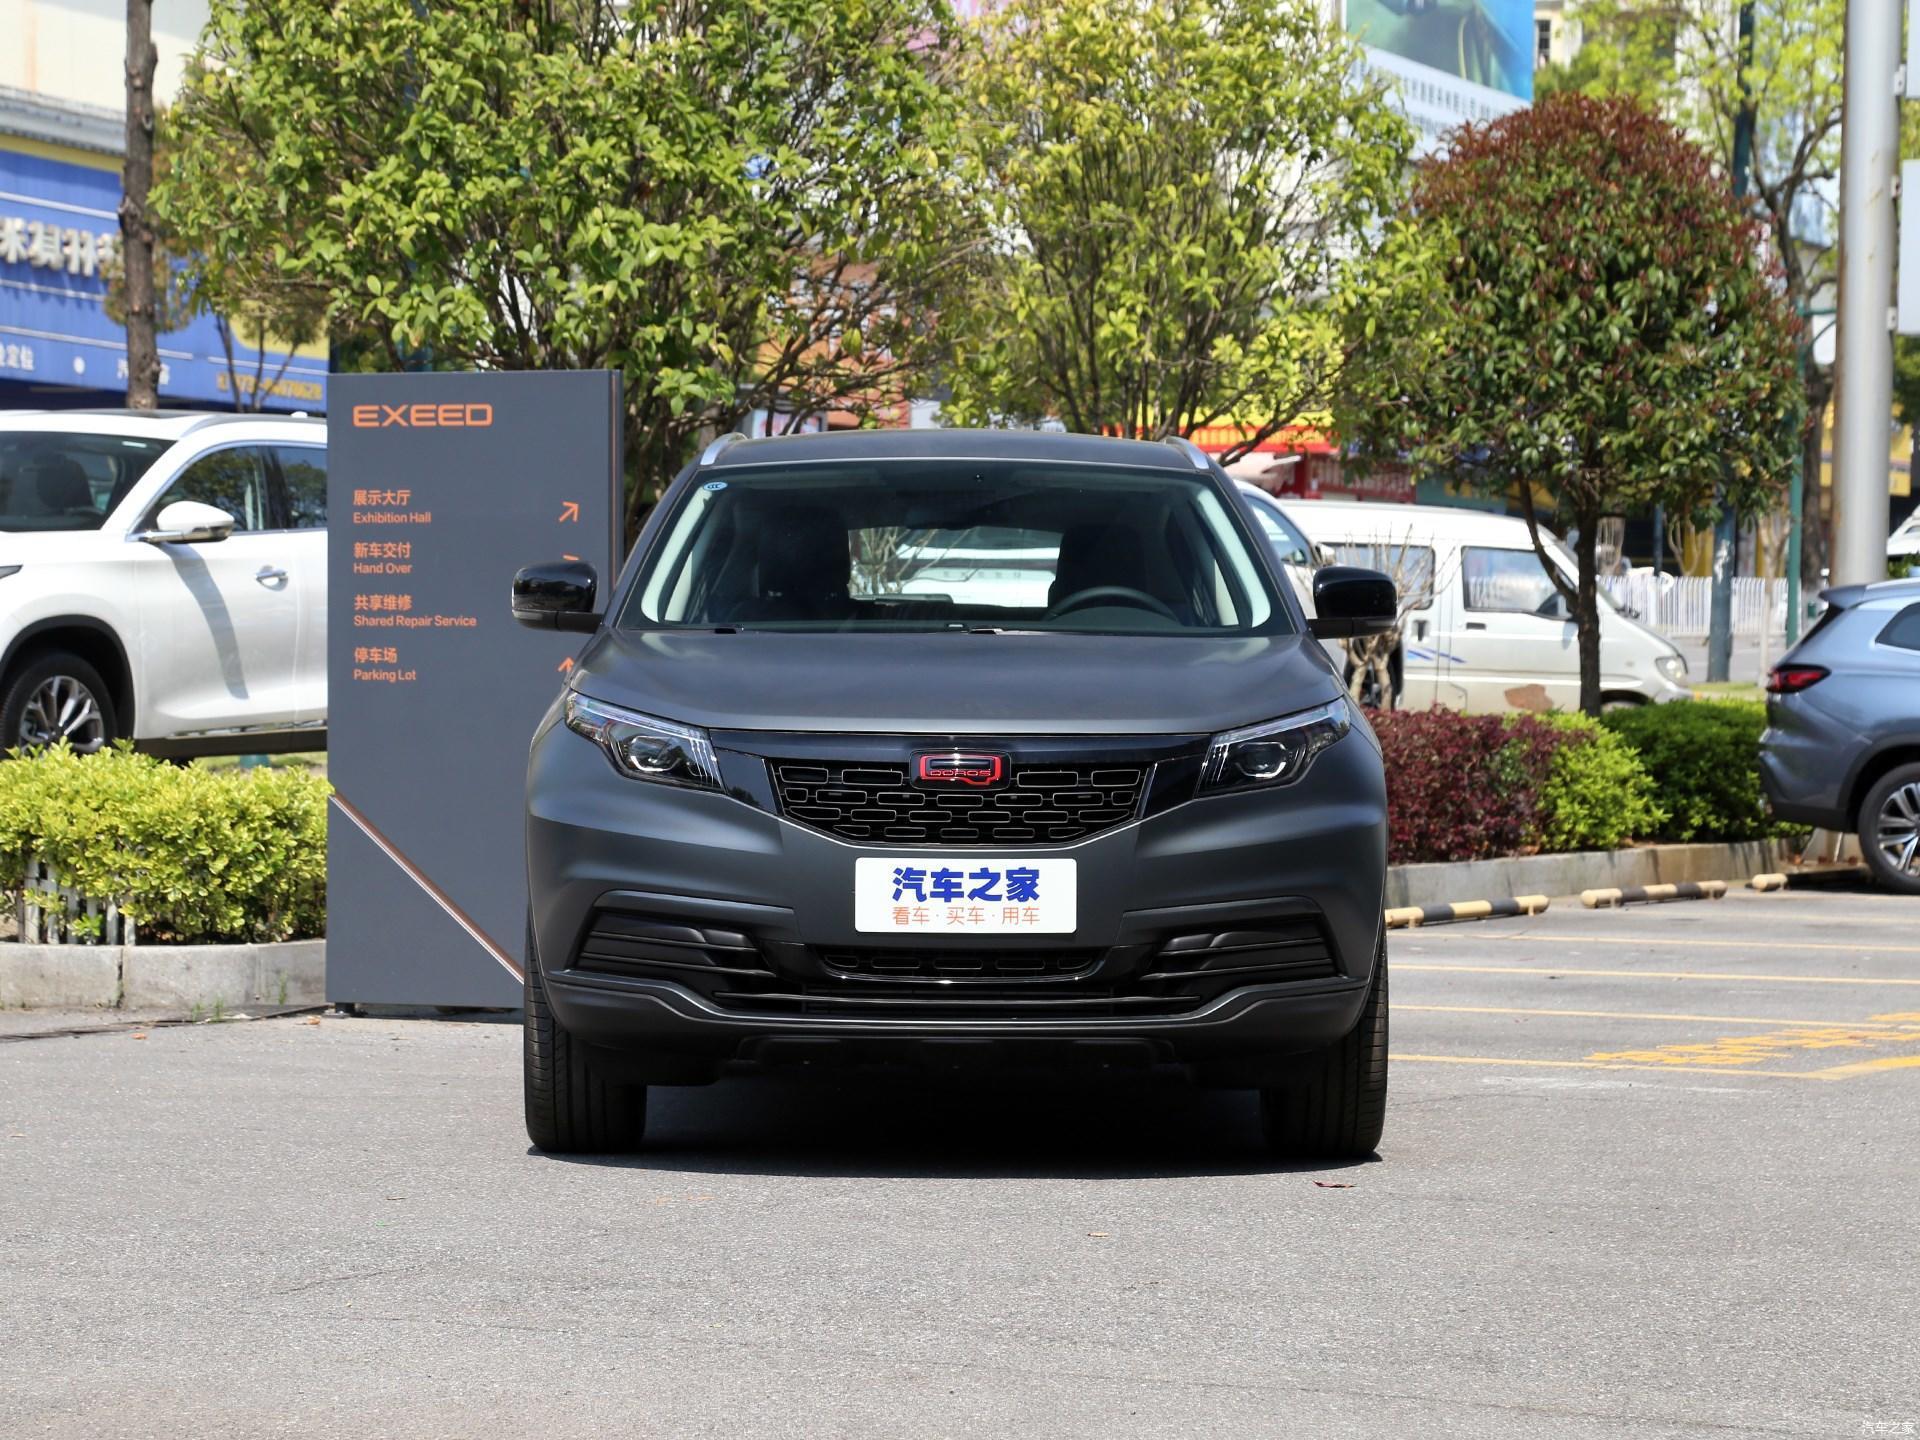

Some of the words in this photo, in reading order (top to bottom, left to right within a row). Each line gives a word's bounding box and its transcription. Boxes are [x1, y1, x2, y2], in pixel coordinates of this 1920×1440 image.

[352, 402, 494, 428] EXEED
[353, 488, 411, 507] 展示大厅
[353, 511, 407, 525] Exhibition
[409, 511, 432, 525] Hall
[353, 541, 412, 560] 新车交付
[353, 562, 384, 575] Hand
[386, 562, 412, 575] Over
[353, 593, 413, 612] 共享维修
[354, 615, 394, 627] Shared
[396, 615, 432, 629] Repair
[434, 615, 477, 627] Service
[354, 647, 398, 665] 停车场
[353, 669, 396, 683] Parking
[398, 669, 417, 681] Lot
[892, 867, 1040, 903] 汽车之家
